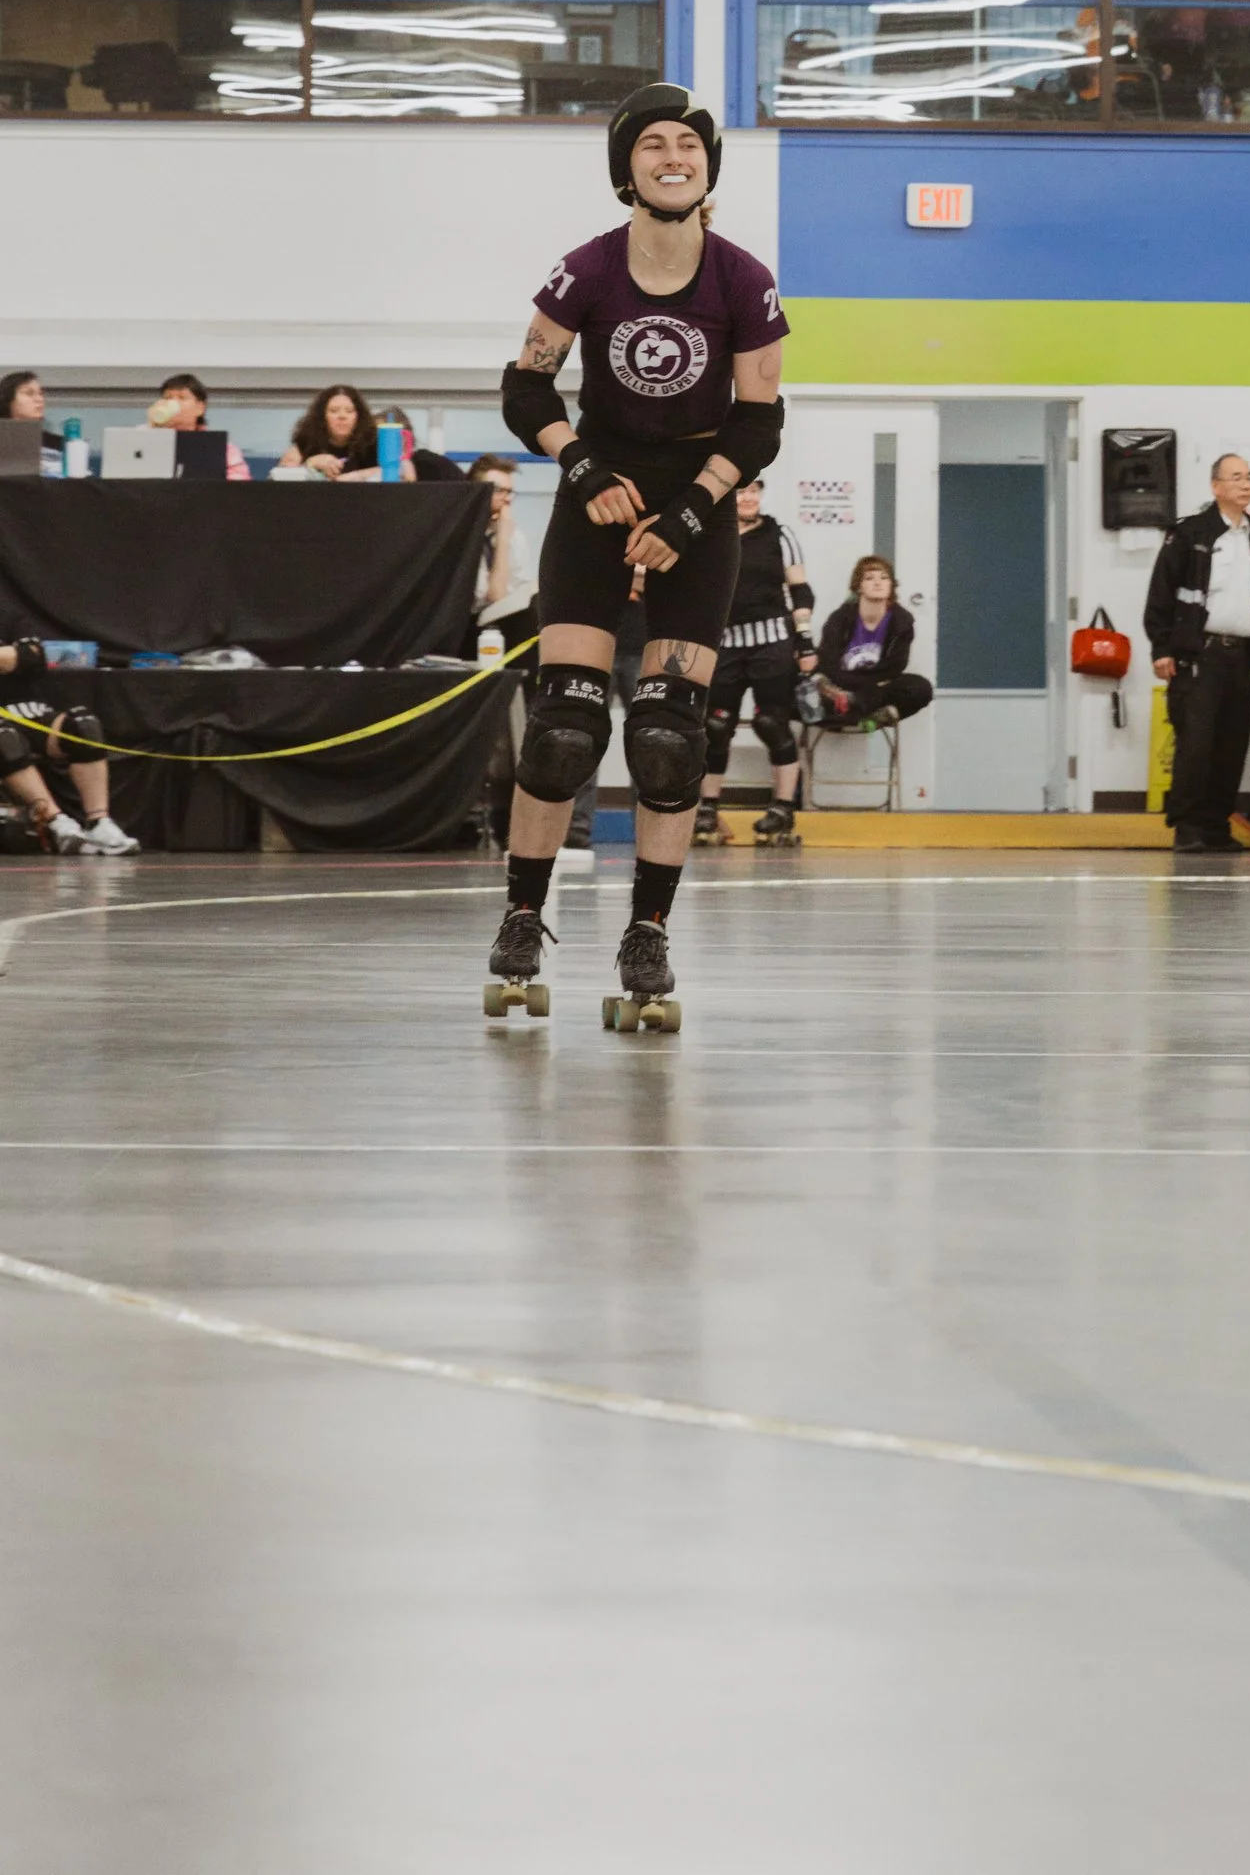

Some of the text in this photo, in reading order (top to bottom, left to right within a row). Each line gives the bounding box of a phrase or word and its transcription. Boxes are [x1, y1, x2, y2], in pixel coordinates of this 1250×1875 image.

[918, 188, 964, 221] EXIT
[546, 259, 575, 301] 21
[611, 323, 634, 351] EVES
[615, 365, 697, 395] ROLLER DERBY
[569, 679, 603, 696] 187
[636, 682, 667, 695] 187
